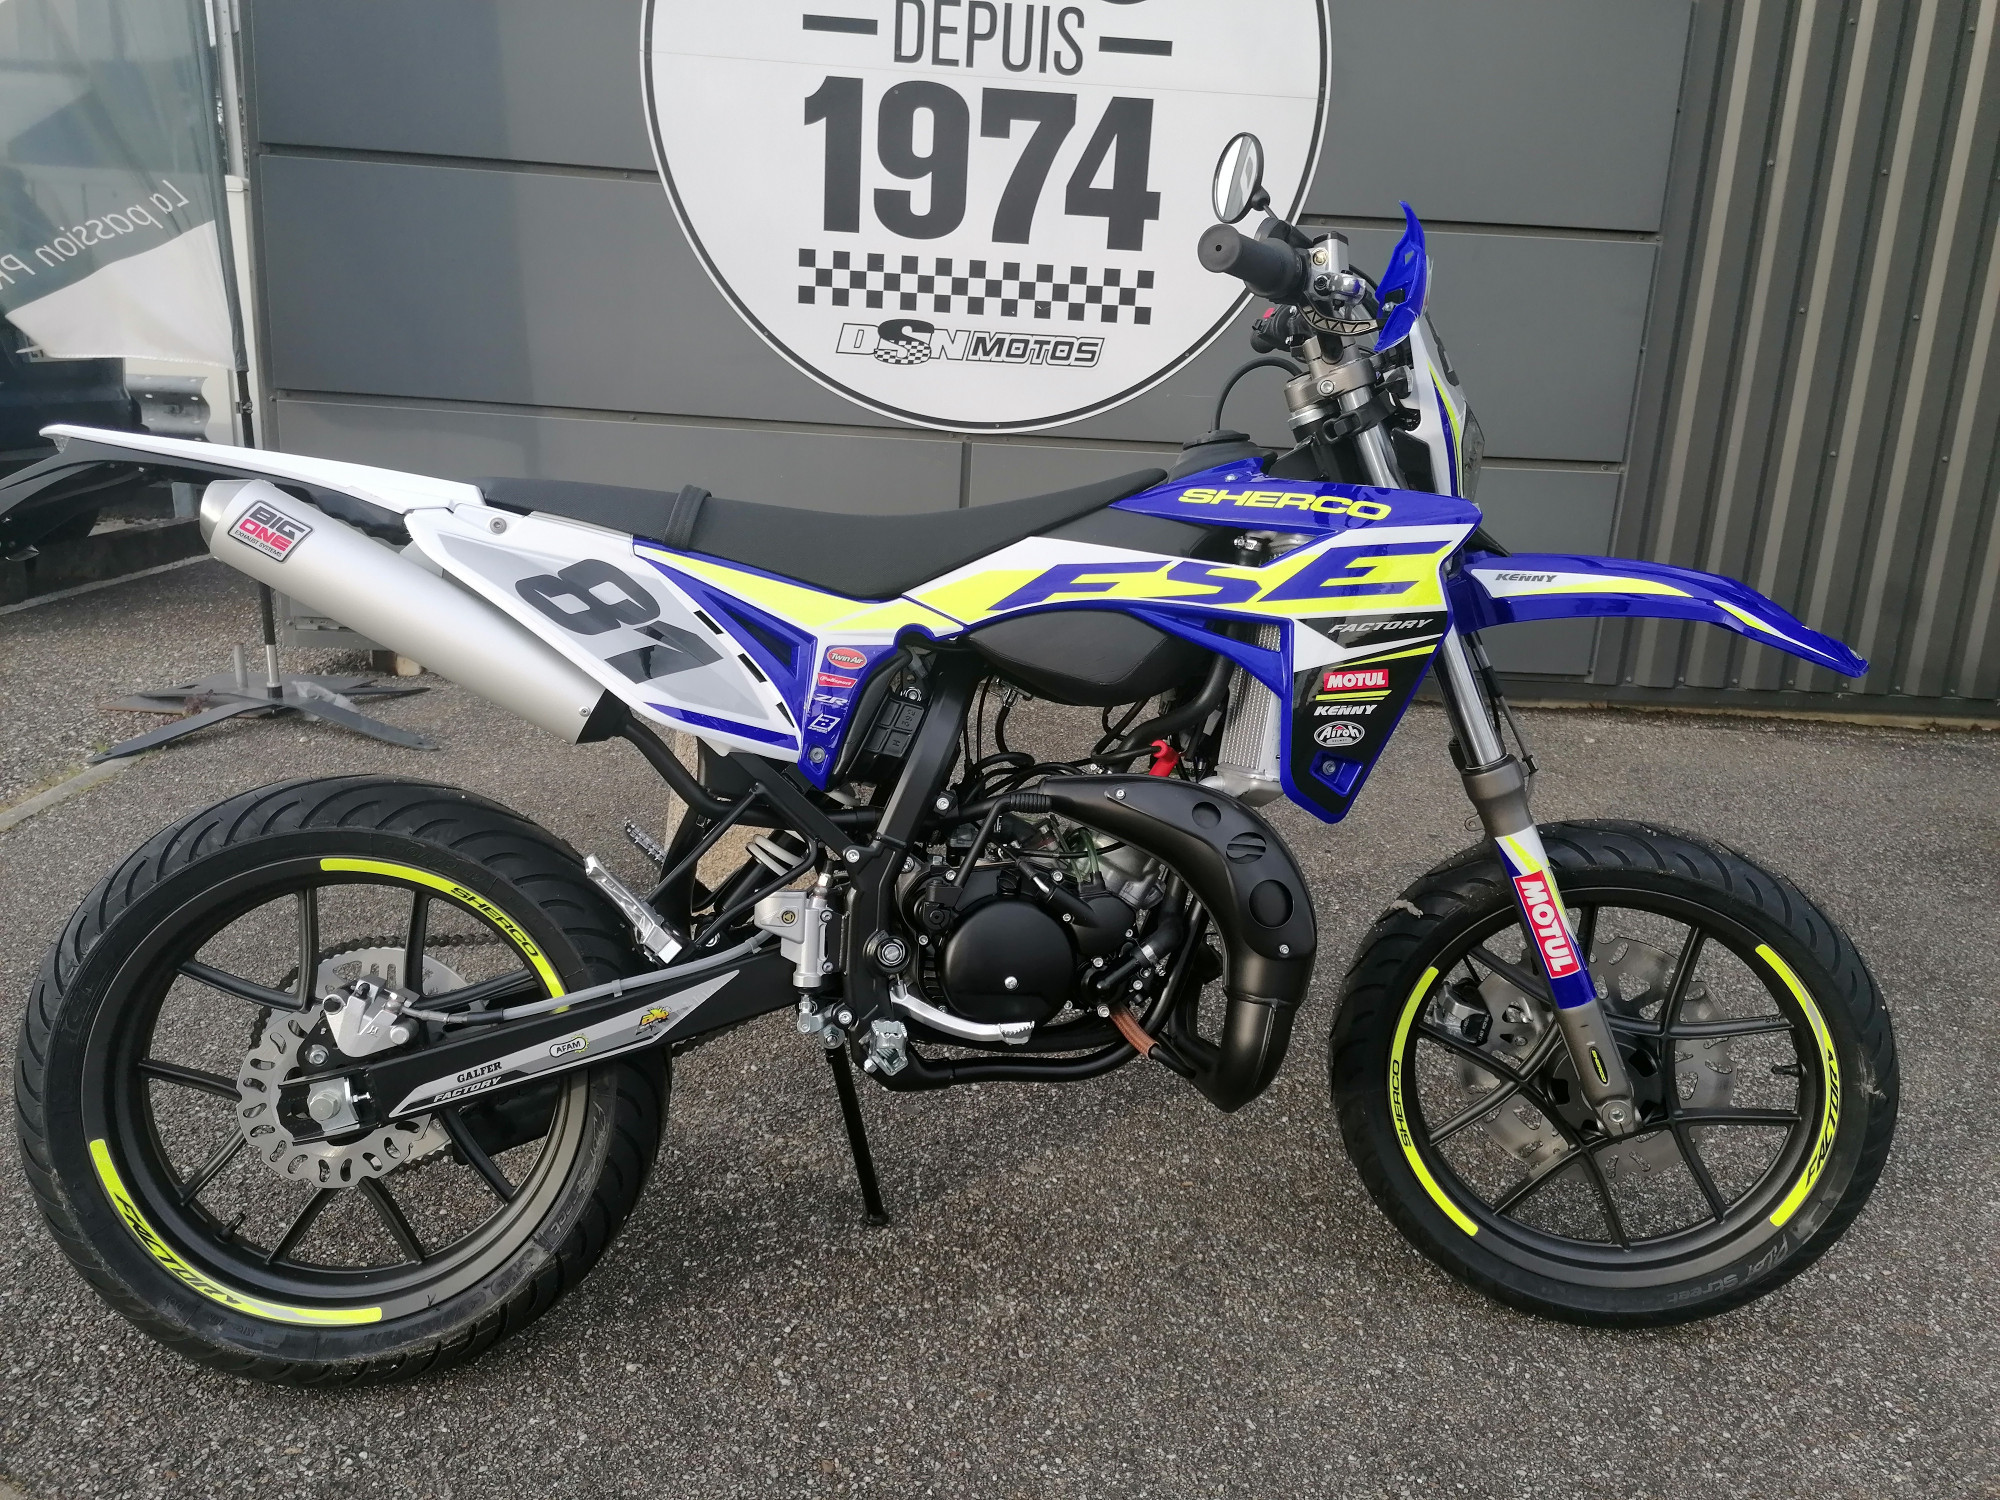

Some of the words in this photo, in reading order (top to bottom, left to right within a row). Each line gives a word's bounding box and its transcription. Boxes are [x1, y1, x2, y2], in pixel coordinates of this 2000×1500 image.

[894, 0, 1085, 76] DEPUIS
[804, 75, 1161, 251] 1974
[836, 319, 971, 365] DSN
[966, 331, 1105, 367] MOTOS
[1178, 488, 1392, 521] SHERCO
[239, 518, 292, 552] ONE
[249, 506, 305, 540] BIG
[235, 529, 259, 546] EXHAUST
[258, 542, 282, 558] SYSTEMS
[1495, 573, 1557, 583] KENNY
[1328, 619, 1434, 634] FACTORY
[1326, 671, 1386, 689] MOTUL
[1313, 704, 1378, 716] KENNY
[1319, 724, 1361, 740] Airoh
[451, 886, 539, 957] SHERCO
[1520, 879, 1575, 972] MOTUL
[555, 1041, 581, 1054] AFAM
[433, 1076, 501, 1102] FACTORY
[457, 1061, 502, 1084] GALFER
[1392, 1060, 1411, 1147] SHERCO
[1804, 1049, 1840, 1188] FACTORY
[113, 1192, 242, 1305] FACTORY
